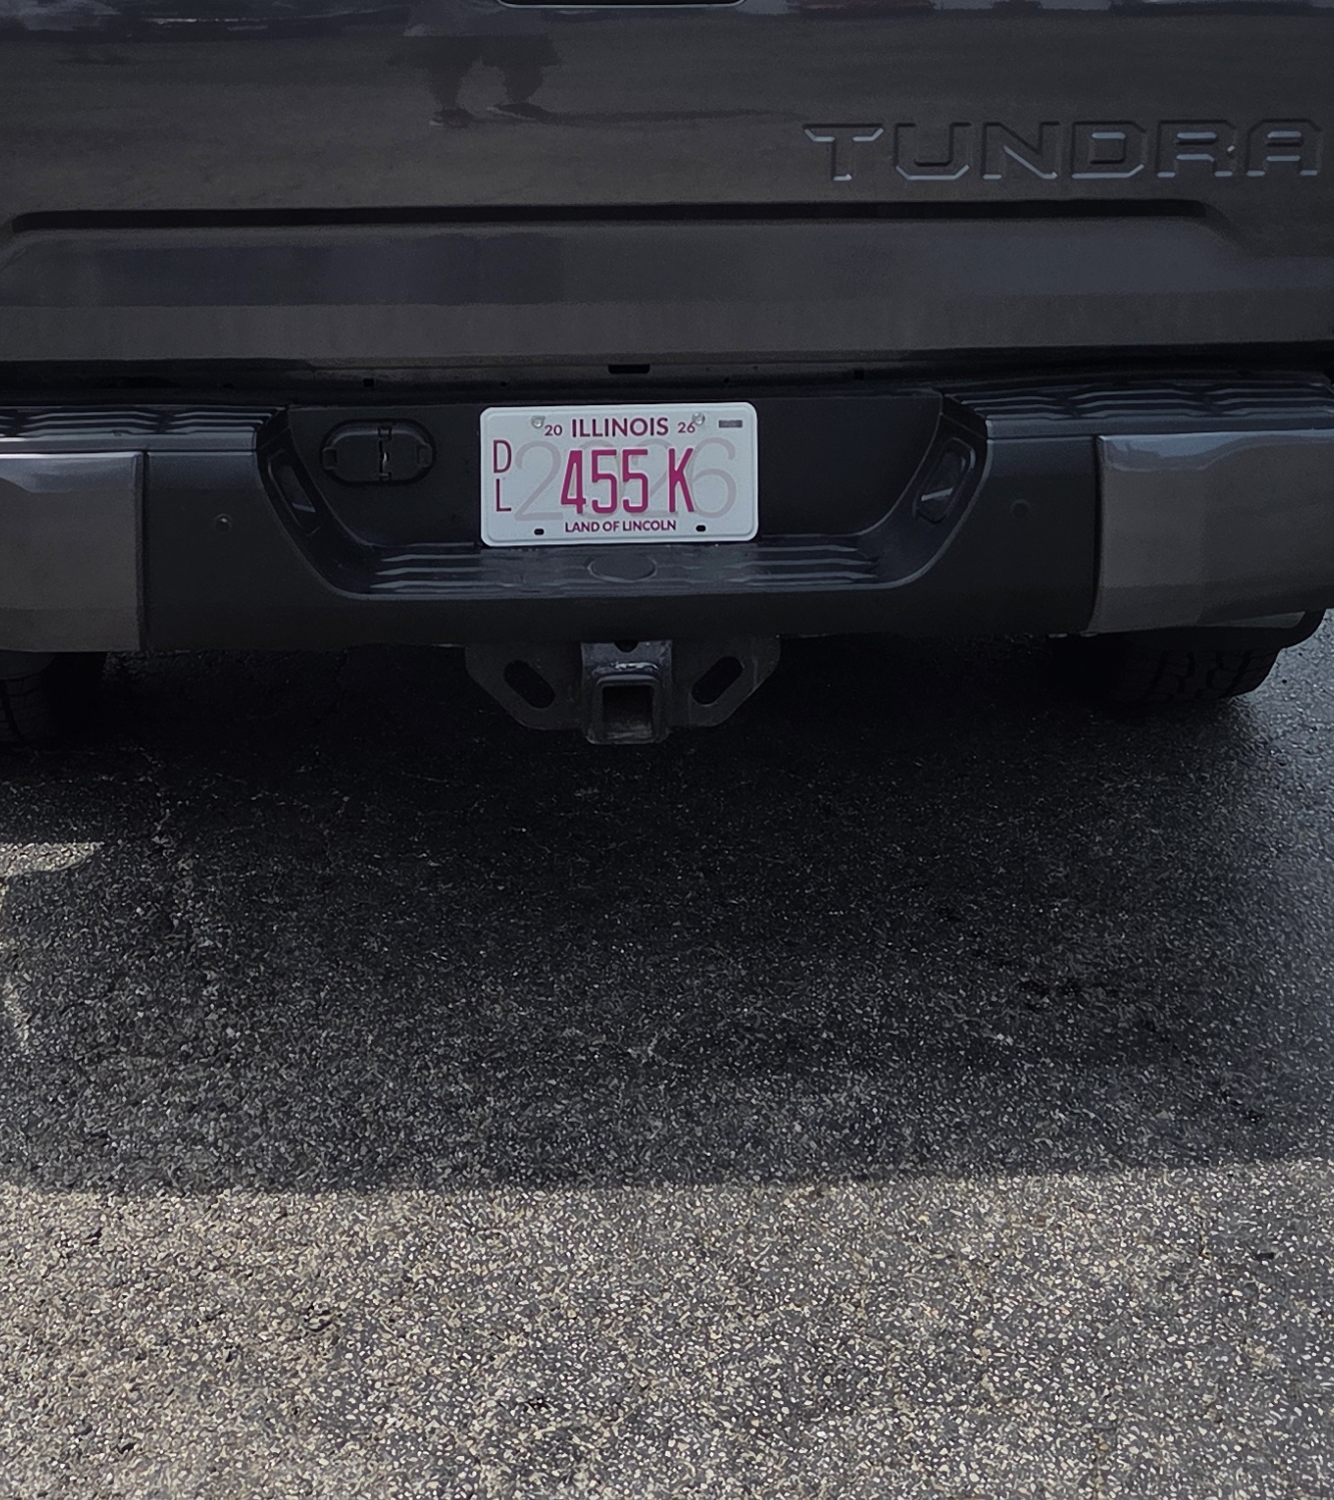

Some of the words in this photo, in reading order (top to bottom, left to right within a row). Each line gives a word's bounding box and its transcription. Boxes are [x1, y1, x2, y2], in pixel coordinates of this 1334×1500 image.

[802, 119, 1322, 182] TUNDRA
[544, 424, 563, 436] 20
[572, 417, 669, 438] ILLINOIS
[677, 421, 696, 434] 26
[560, 448, 649, 514] 455
[668, 447, 695, 513] K
[565, 521, 600, 533] LAND
[602, 521, 620, 532] OF
[622, 519, 676, 531] LINCOLN
